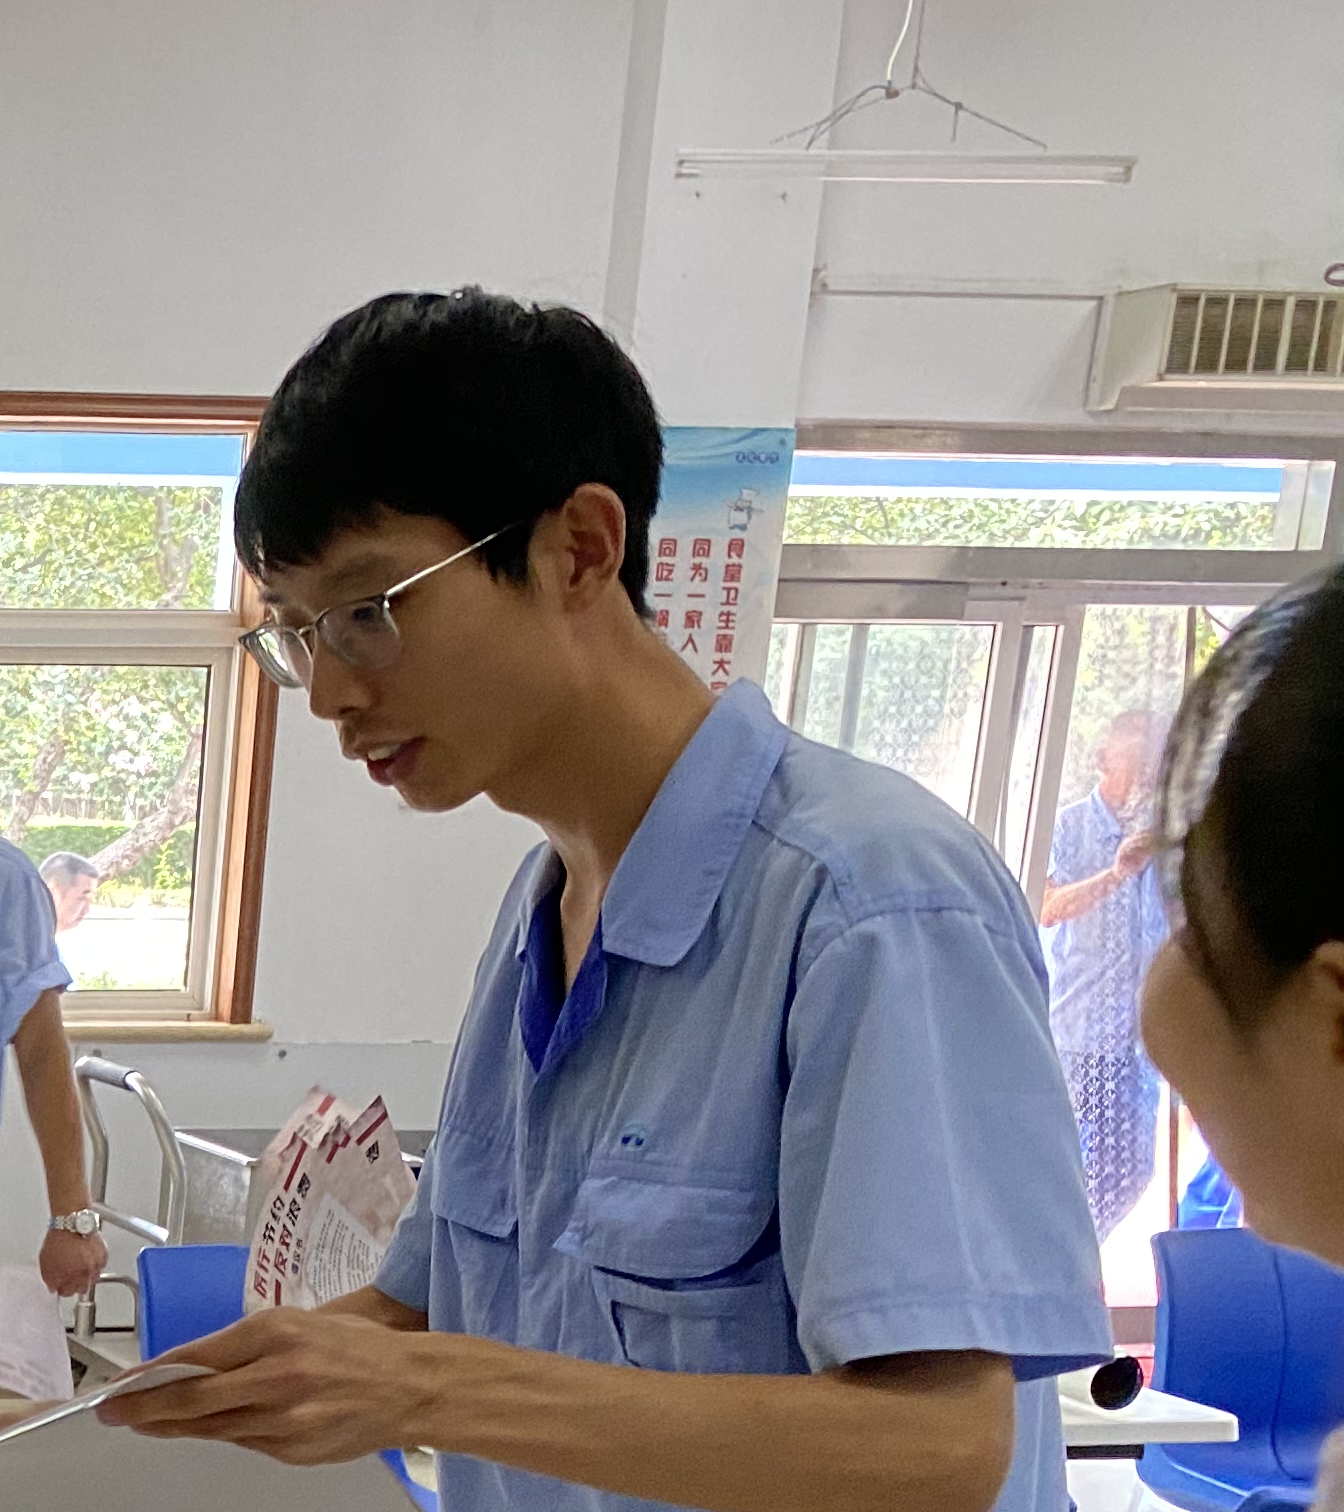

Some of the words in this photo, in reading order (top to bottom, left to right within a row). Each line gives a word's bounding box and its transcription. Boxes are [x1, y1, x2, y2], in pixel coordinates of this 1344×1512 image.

[680, 538, 711, 653] 同为一家人
[254, 1196, 285, 1299] 厉行节约
